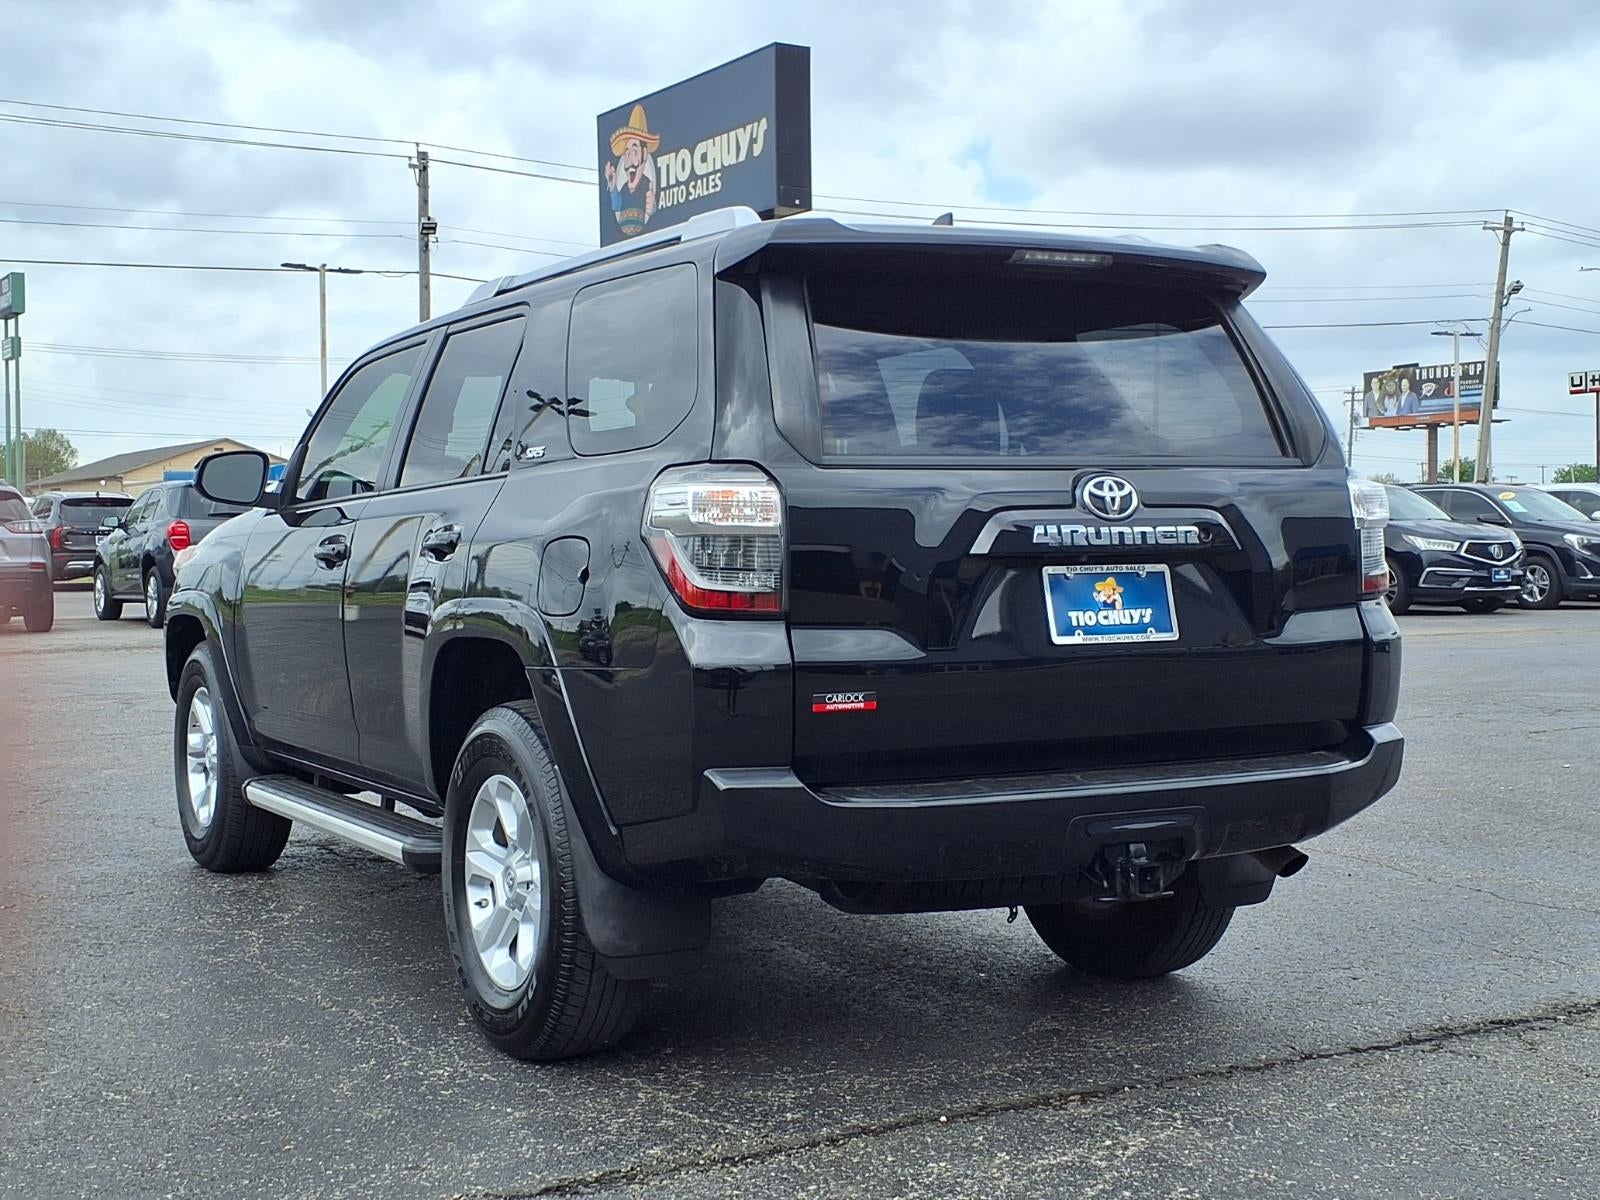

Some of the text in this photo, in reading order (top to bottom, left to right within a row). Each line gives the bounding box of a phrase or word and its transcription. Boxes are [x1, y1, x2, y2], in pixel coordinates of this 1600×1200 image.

[657, 117, 768, 188] TIO CHUY'S
[658, 172, 722, 209] AUTO SALES
[1415, 365, 1463, 380] THUNDER
[1068, 608, 1153, 627] TIO CHUY'S
[825, 693, 865, 703] CARLOCK
[825, 702, 865, 710] AUTOMOTIVE
